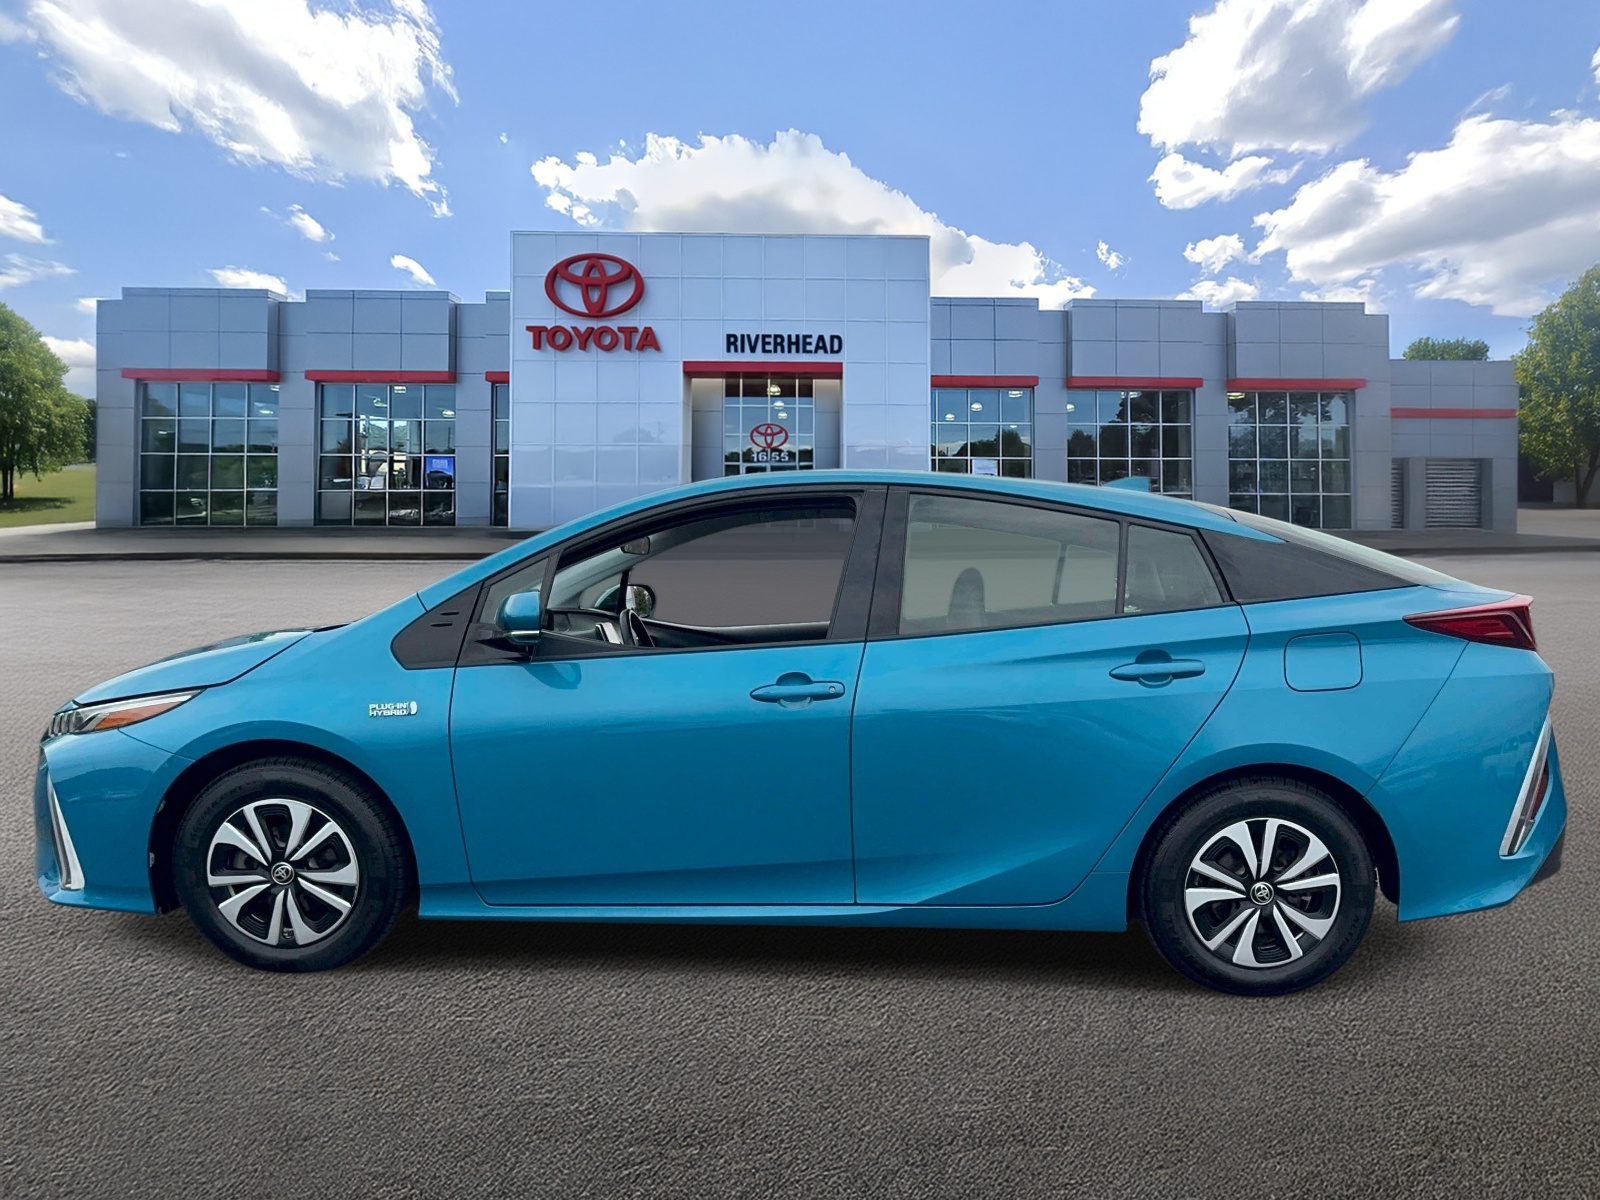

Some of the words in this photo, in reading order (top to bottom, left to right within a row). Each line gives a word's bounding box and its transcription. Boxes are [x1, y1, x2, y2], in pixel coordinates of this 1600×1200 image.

[525, 325, 662, 352] TOYOTA
[725, 333, 844, 354] RIVERHEAD
[752, 451, 789, 462] 1655
[369, 709, 407, 717] HYBRID
